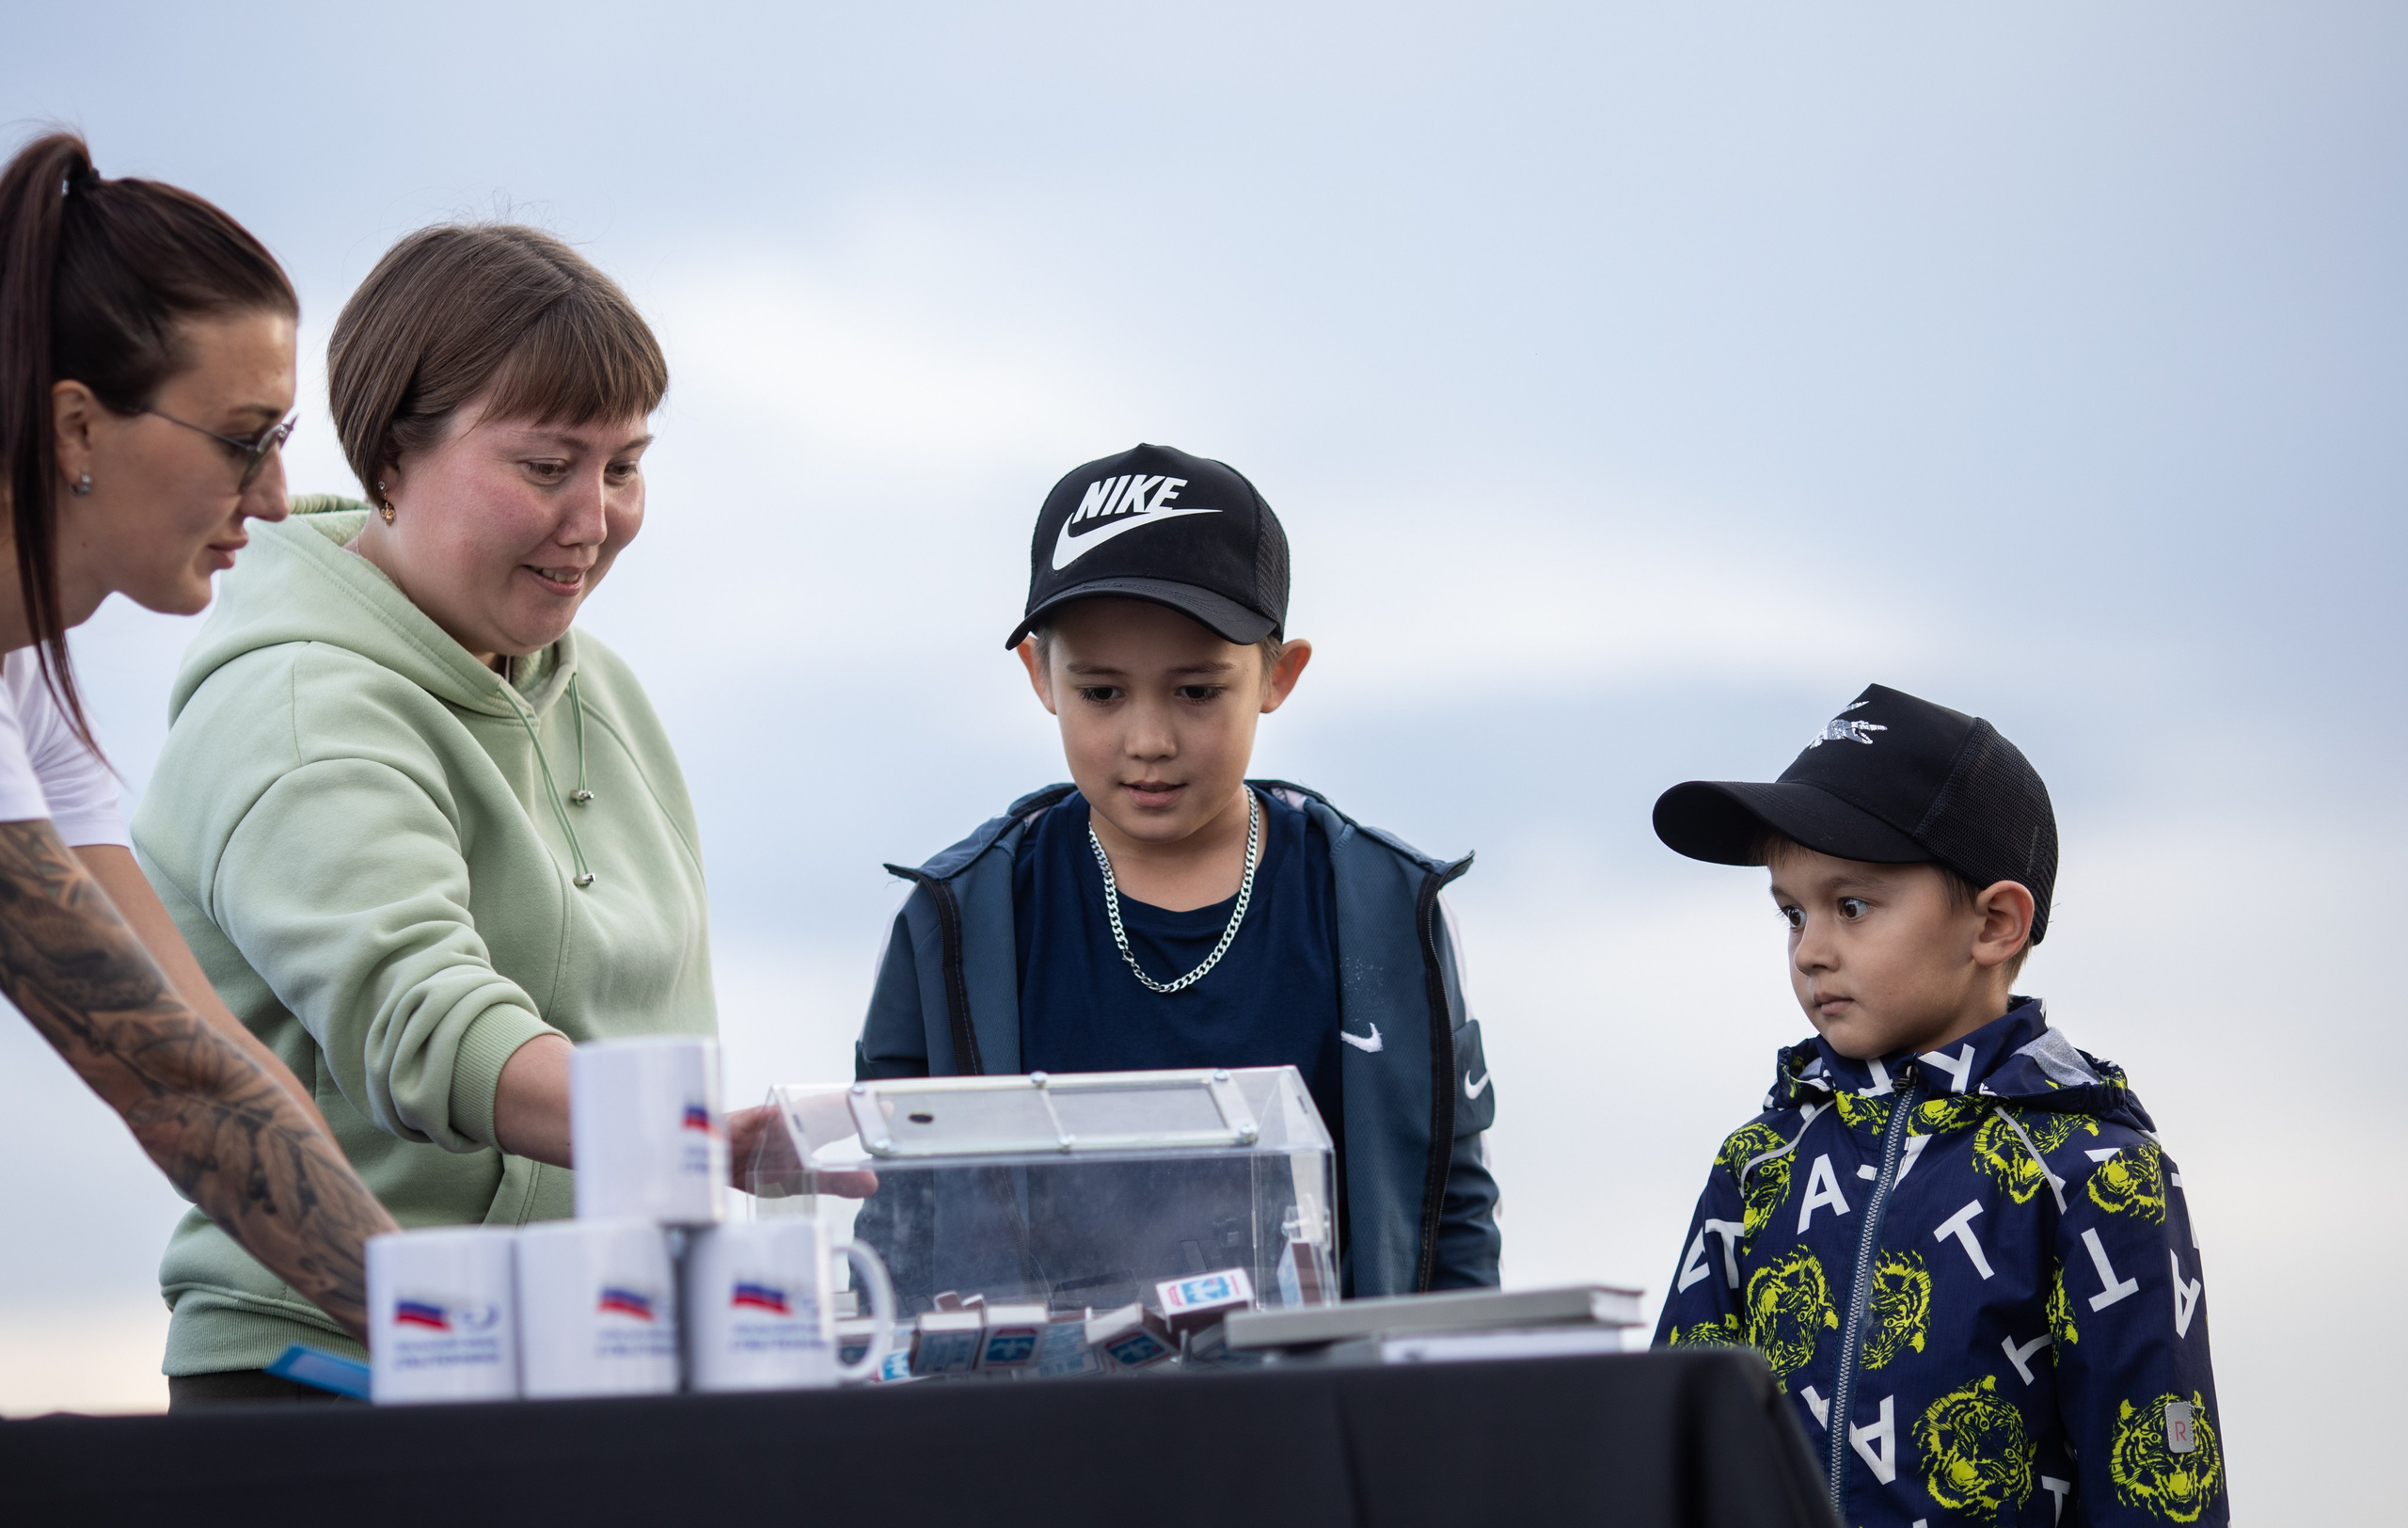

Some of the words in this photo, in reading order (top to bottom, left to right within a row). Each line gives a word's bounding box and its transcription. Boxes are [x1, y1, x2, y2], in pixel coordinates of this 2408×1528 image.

[1071, 474, 1188, 524] NIKE
[1798, 1154, 1850, 1235] A
[1704, 1218, 1745, 1289] T
[1933, 1199, 1994, 1281] T
[2081, 1227, 2140, 1313] T
[2170, 1248, 2202, 1340] A
[1849, 1394, 1896, 1487] A
[2175, 1421, 2187, 1441] R
